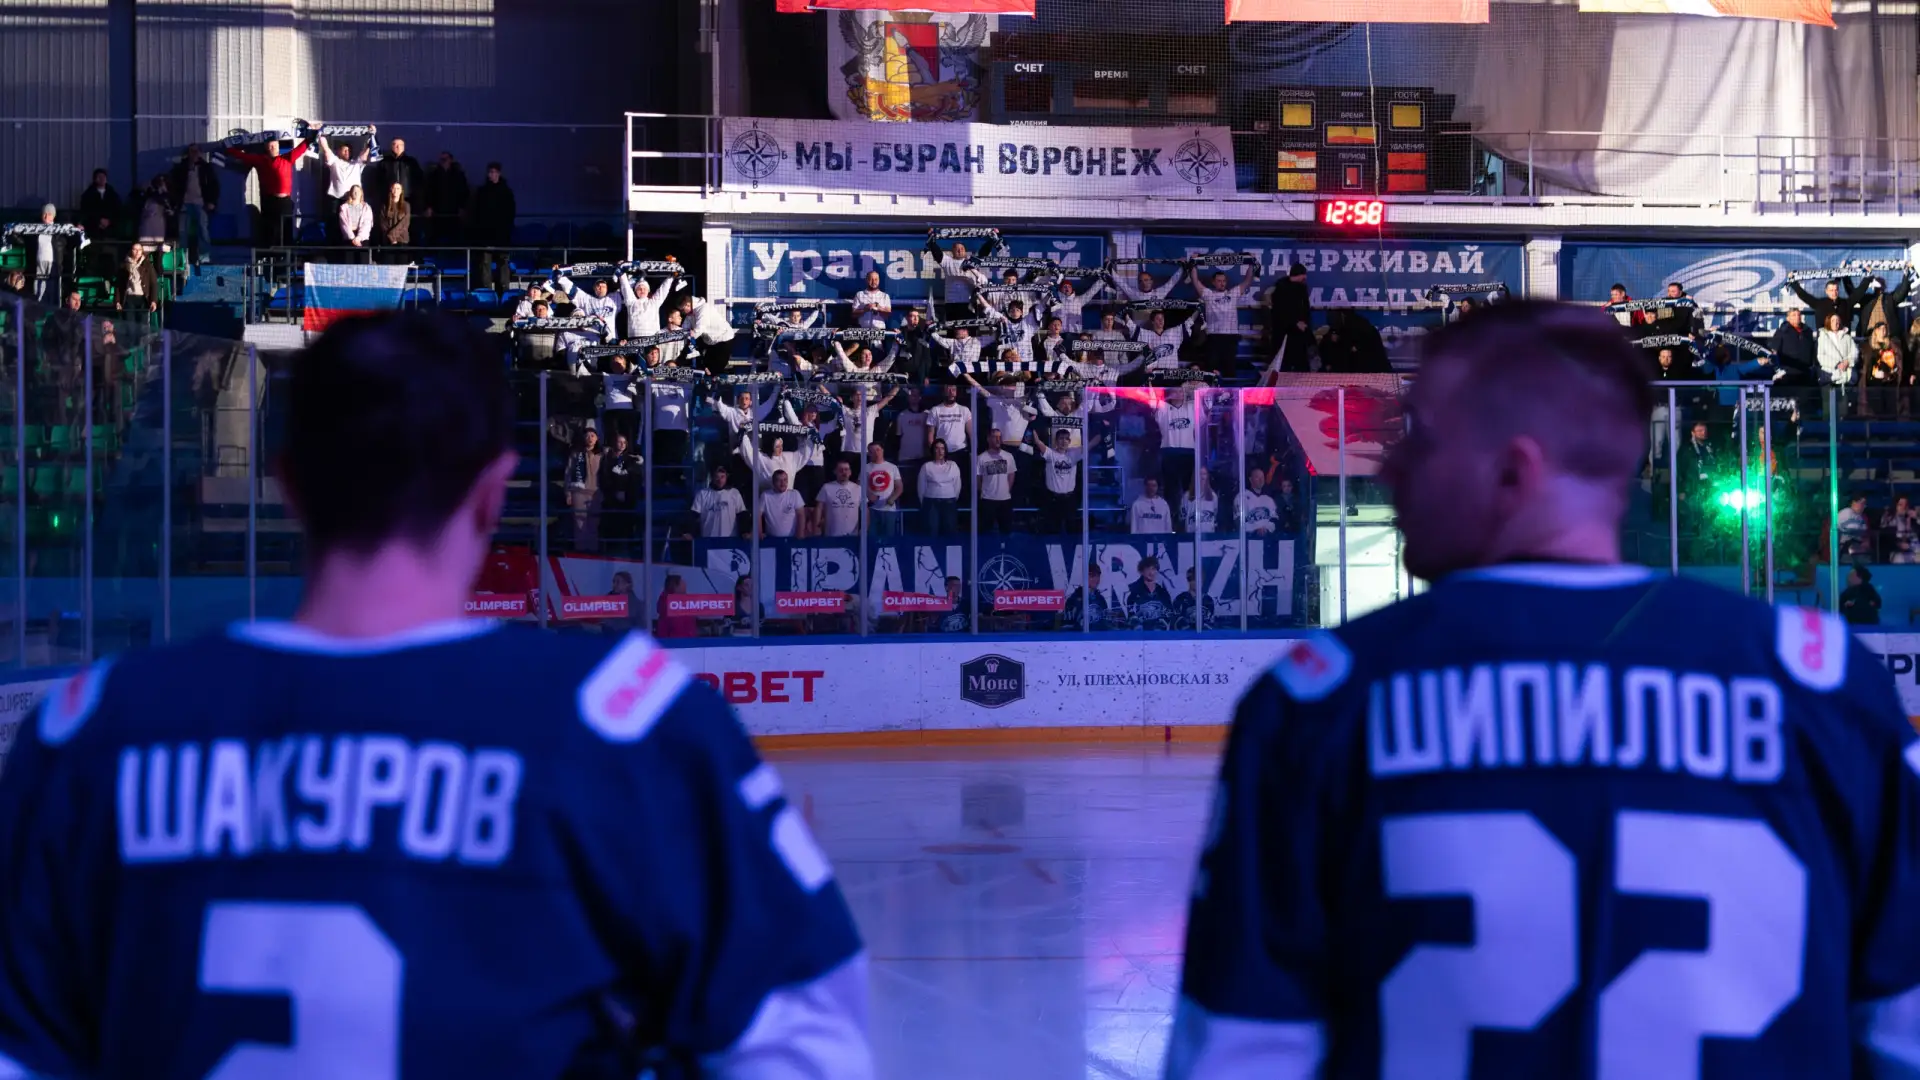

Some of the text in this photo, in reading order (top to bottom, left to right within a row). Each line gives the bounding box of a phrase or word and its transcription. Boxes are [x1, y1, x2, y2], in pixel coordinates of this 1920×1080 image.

[1014, 63, 1045, 73] СЧЕТ
[1176, 65, 1207, 75] СЧЕТ
[1094, 70, 1129, 79] ВРЕМЯ
[1279, 90, 1316, 98] ХОЗЯЕВА
[1394, 91, 1420, 99] ГОСТИ
[796, 141, 985, 174] МЫ-БУРАН
[998, 143, 1163, 176] ВОРОНЕЖ
[752, 180, 759, 190] В
[1196, 186, 1203, 195] В
[1324, 200, 1384, 226] 12:58
[843, 329, 886, 339] БУРАН
[1072, 340, 1147, 351] ВОРОНЕЖ
[652, 367, 695, 379] БУРАН
[744, 422, 809, 435] УАГАННЫЕ
[464, 600, 525, 611] OLIMPBET
[669, 600, 733, 610] OLIMPBET
[778, 597, 843, 608] OLIMPBET
[996, 595, 1063, 605] OLIMPBET
[563, 601, 627, 612] OLIMPBET
[968, 674, 1019, 691] Моне
[1084, 672, 1211, 686] ПЛЕХАНОВСКАЯ
[1214, 672, 1230, 684] 33
[1367, 661, 1784, 785] ШИПИЛОВ
[117, 734, 523, 866] ШАКУРОВ
[1378, 808, 1809, 1080] 22
